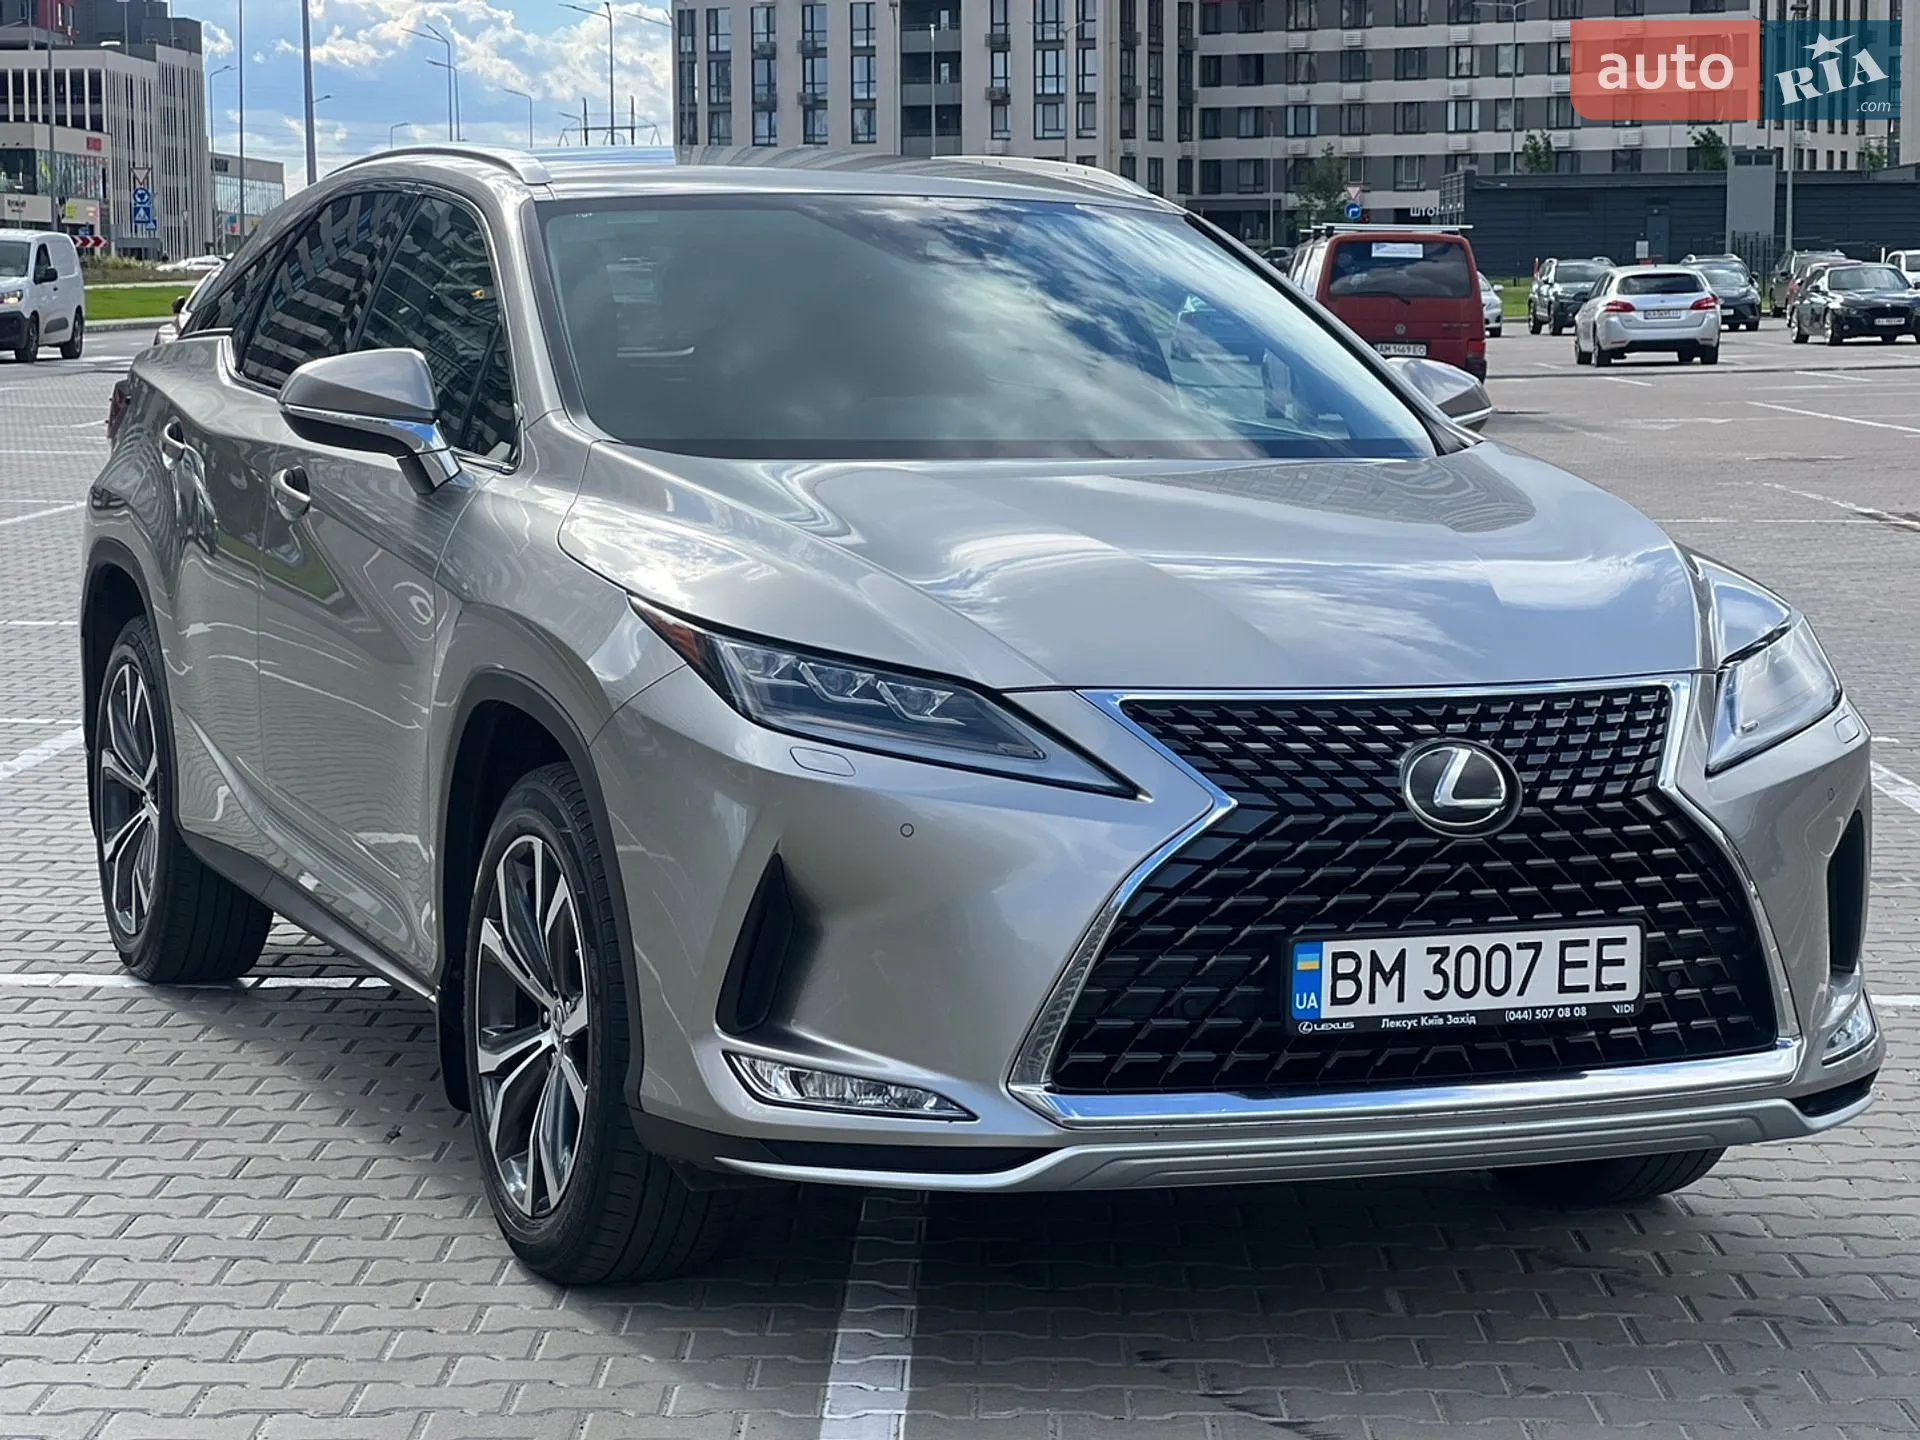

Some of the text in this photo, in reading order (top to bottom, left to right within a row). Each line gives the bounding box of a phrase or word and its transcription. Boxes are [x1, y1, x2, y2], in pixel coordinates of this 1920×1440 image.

[1329, 937, 1628, 1006] BM 3007 EE
[1295, 991, 1319, 1010] UA
[1505, 1006, 1587, 1022] (044) 507 08 08
[1612, 1004, 1635, 1015] VIDI
[1314, 1021, 1355, 1031] LEXUS
[1381, 1012, 1476, 1030] Лексус Київ Захід
